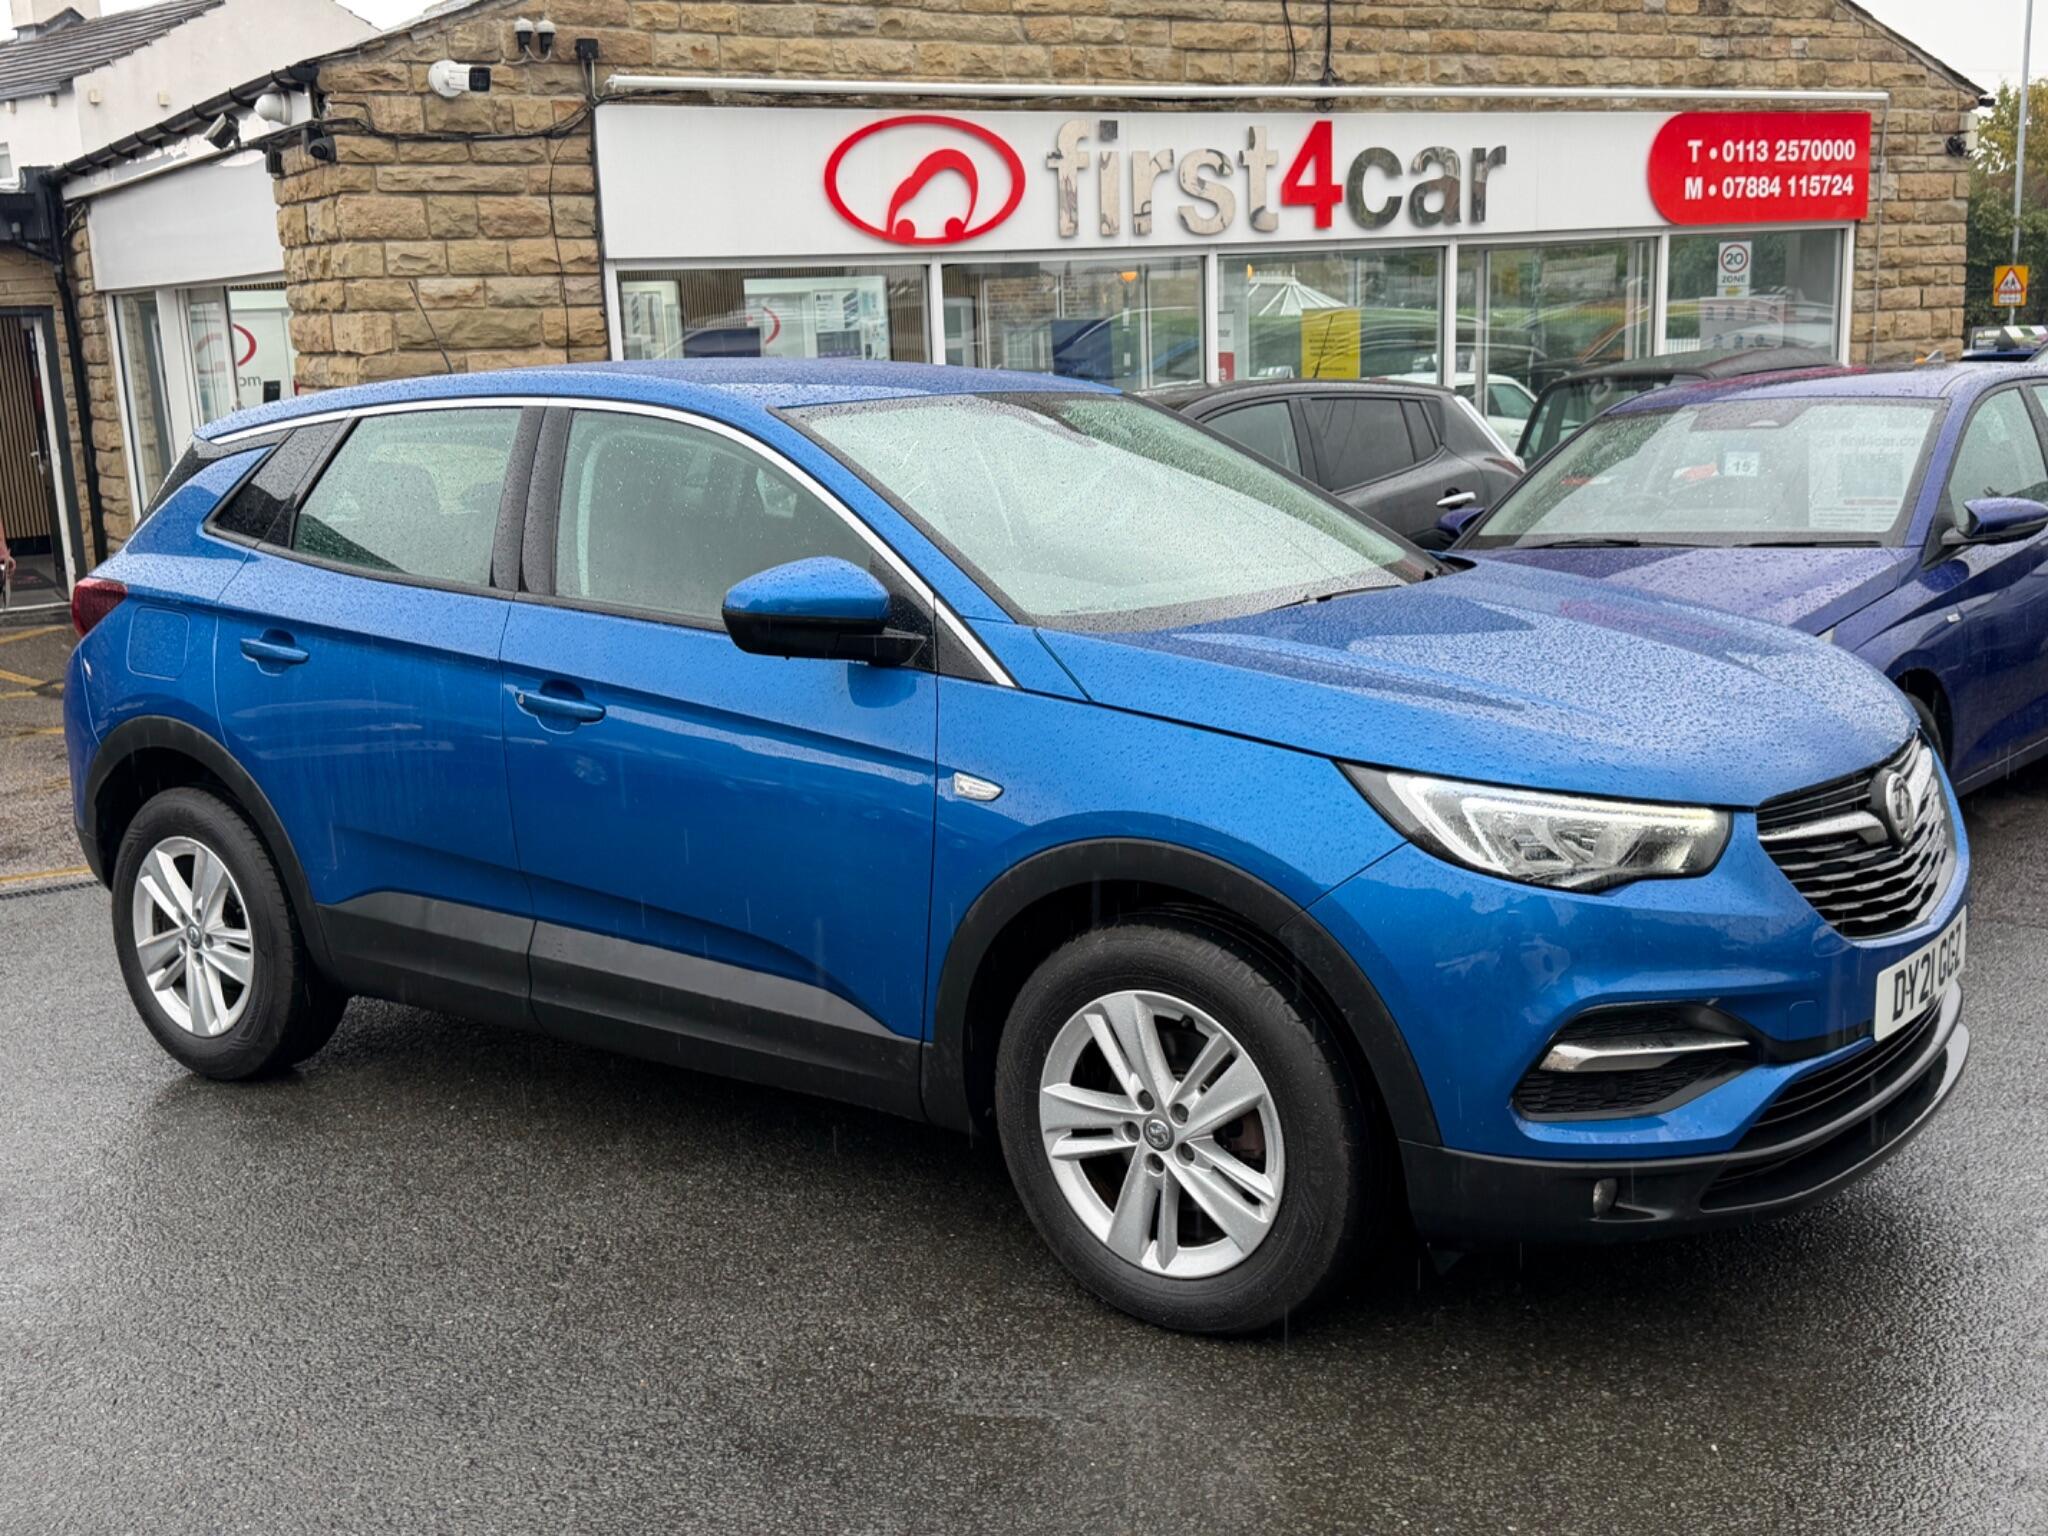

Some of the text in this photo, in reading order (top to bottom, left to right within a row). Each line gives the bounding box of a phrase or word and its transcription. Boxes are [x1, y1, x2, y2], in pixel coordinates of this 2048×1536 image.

[1687, 139, 1856, 163] T 0113 2570000
[1046, 118, 1507, 237] first4car
[1684, 174, 1854, 200] M 07884 115724
[1726, 253, 1744, 265] 20
[1722, 275, 1746, 284] ZONE
[1892, 947, 1936, 1022] DY21
